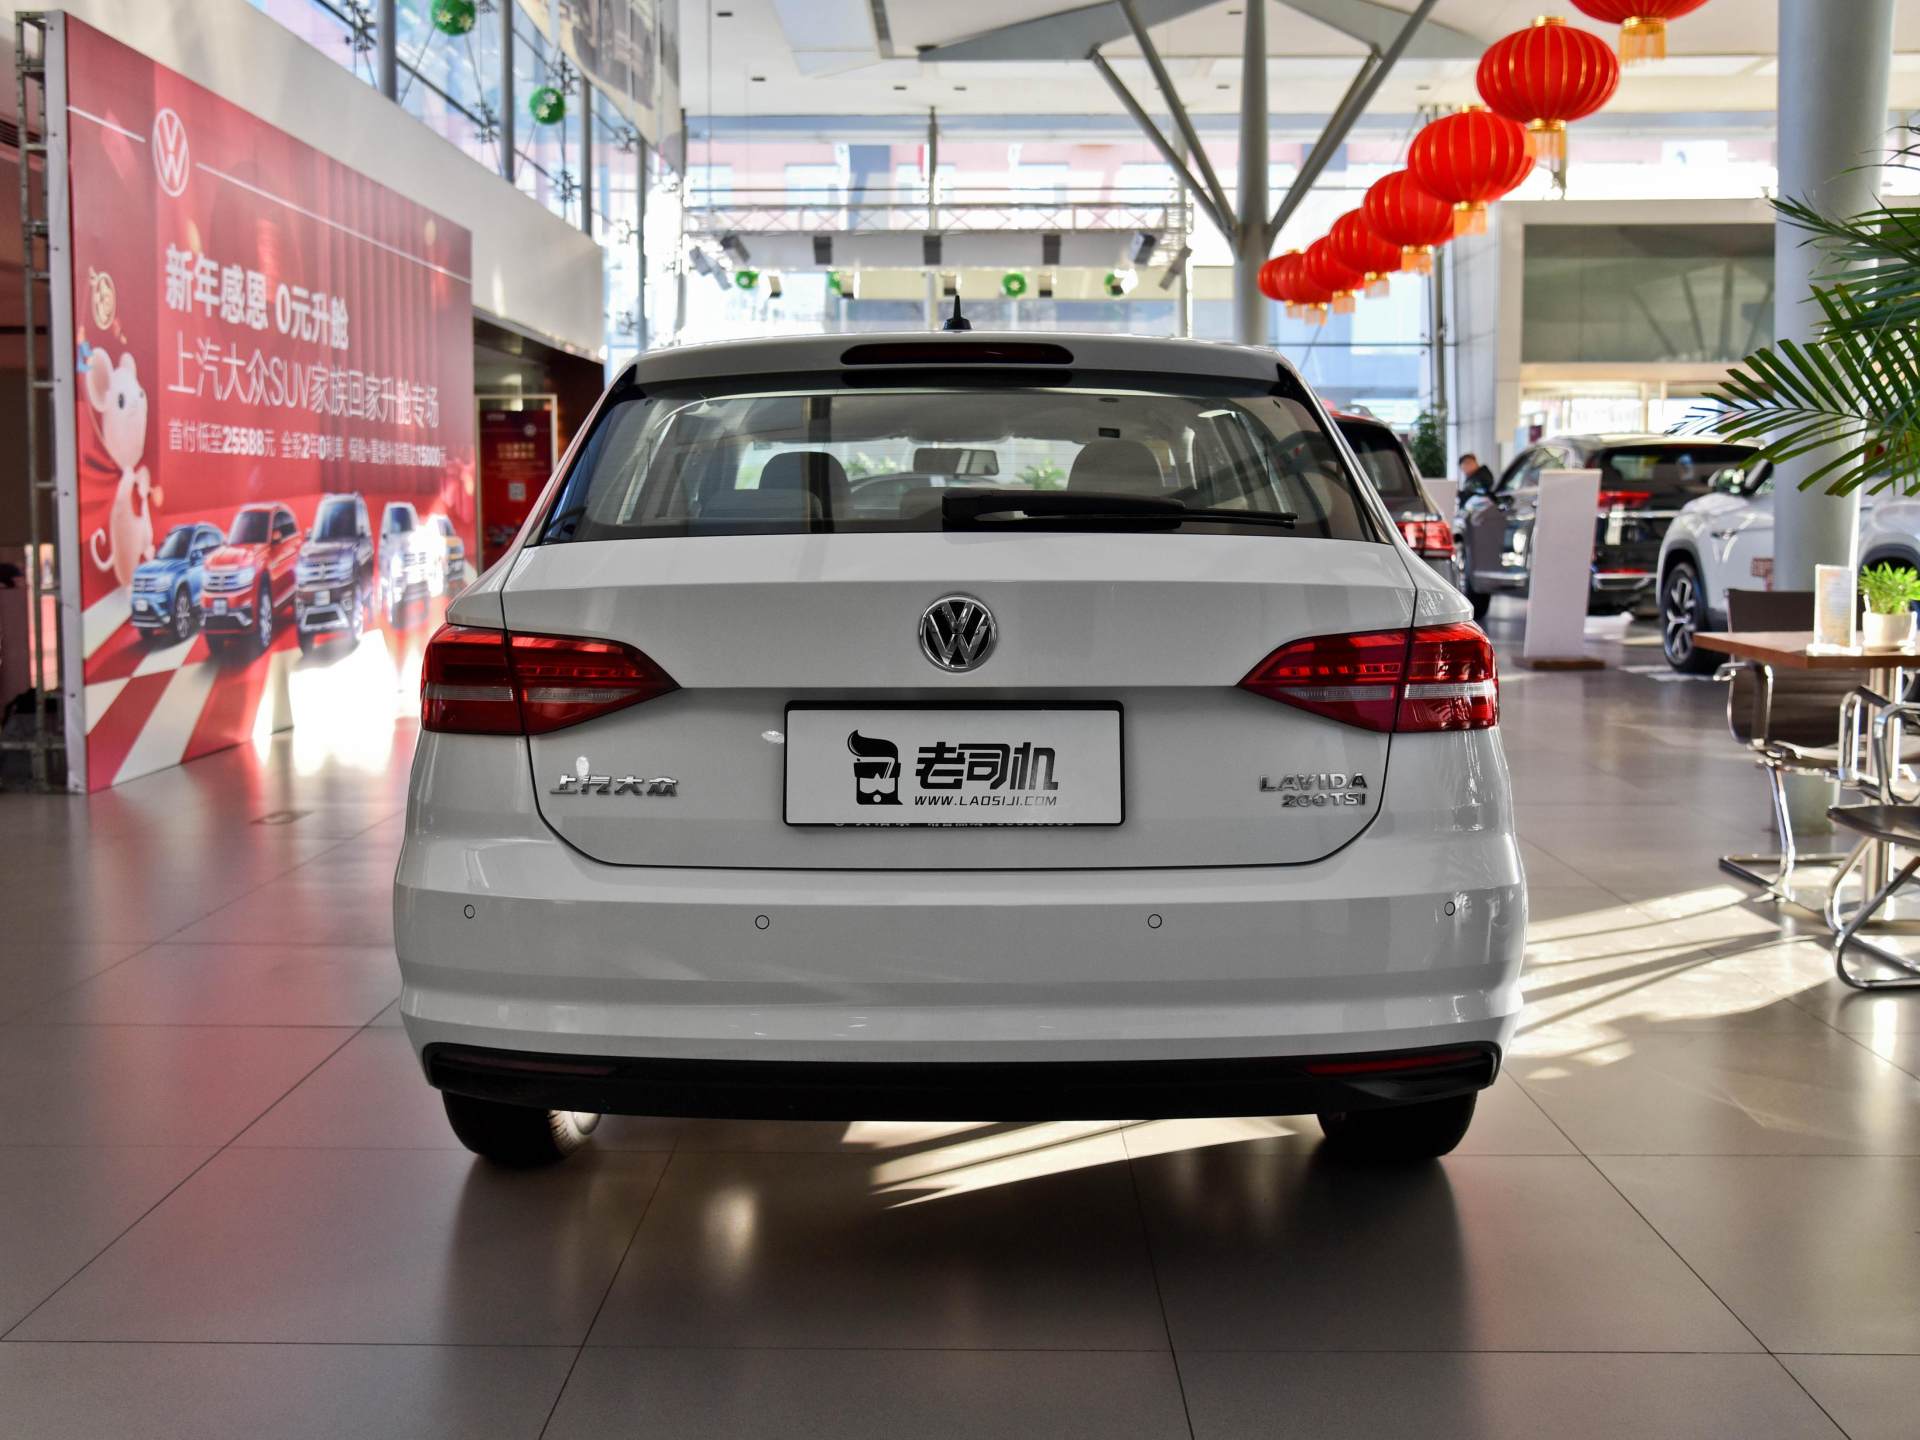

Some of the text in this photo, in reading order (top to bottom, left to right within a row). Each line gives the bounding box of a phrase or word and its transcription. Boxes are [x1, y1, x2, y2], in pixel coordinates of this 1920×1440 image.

[165, 243, 270, 331] 新年感恩
[275, 283, 350, 350] 0元升舱
[915, 741, 1058, 790] 老司机
[1260, 772, 1368, 792] LAVIDA
[914, 795, 1057, 806] WWW.LAOSIJI.COM
